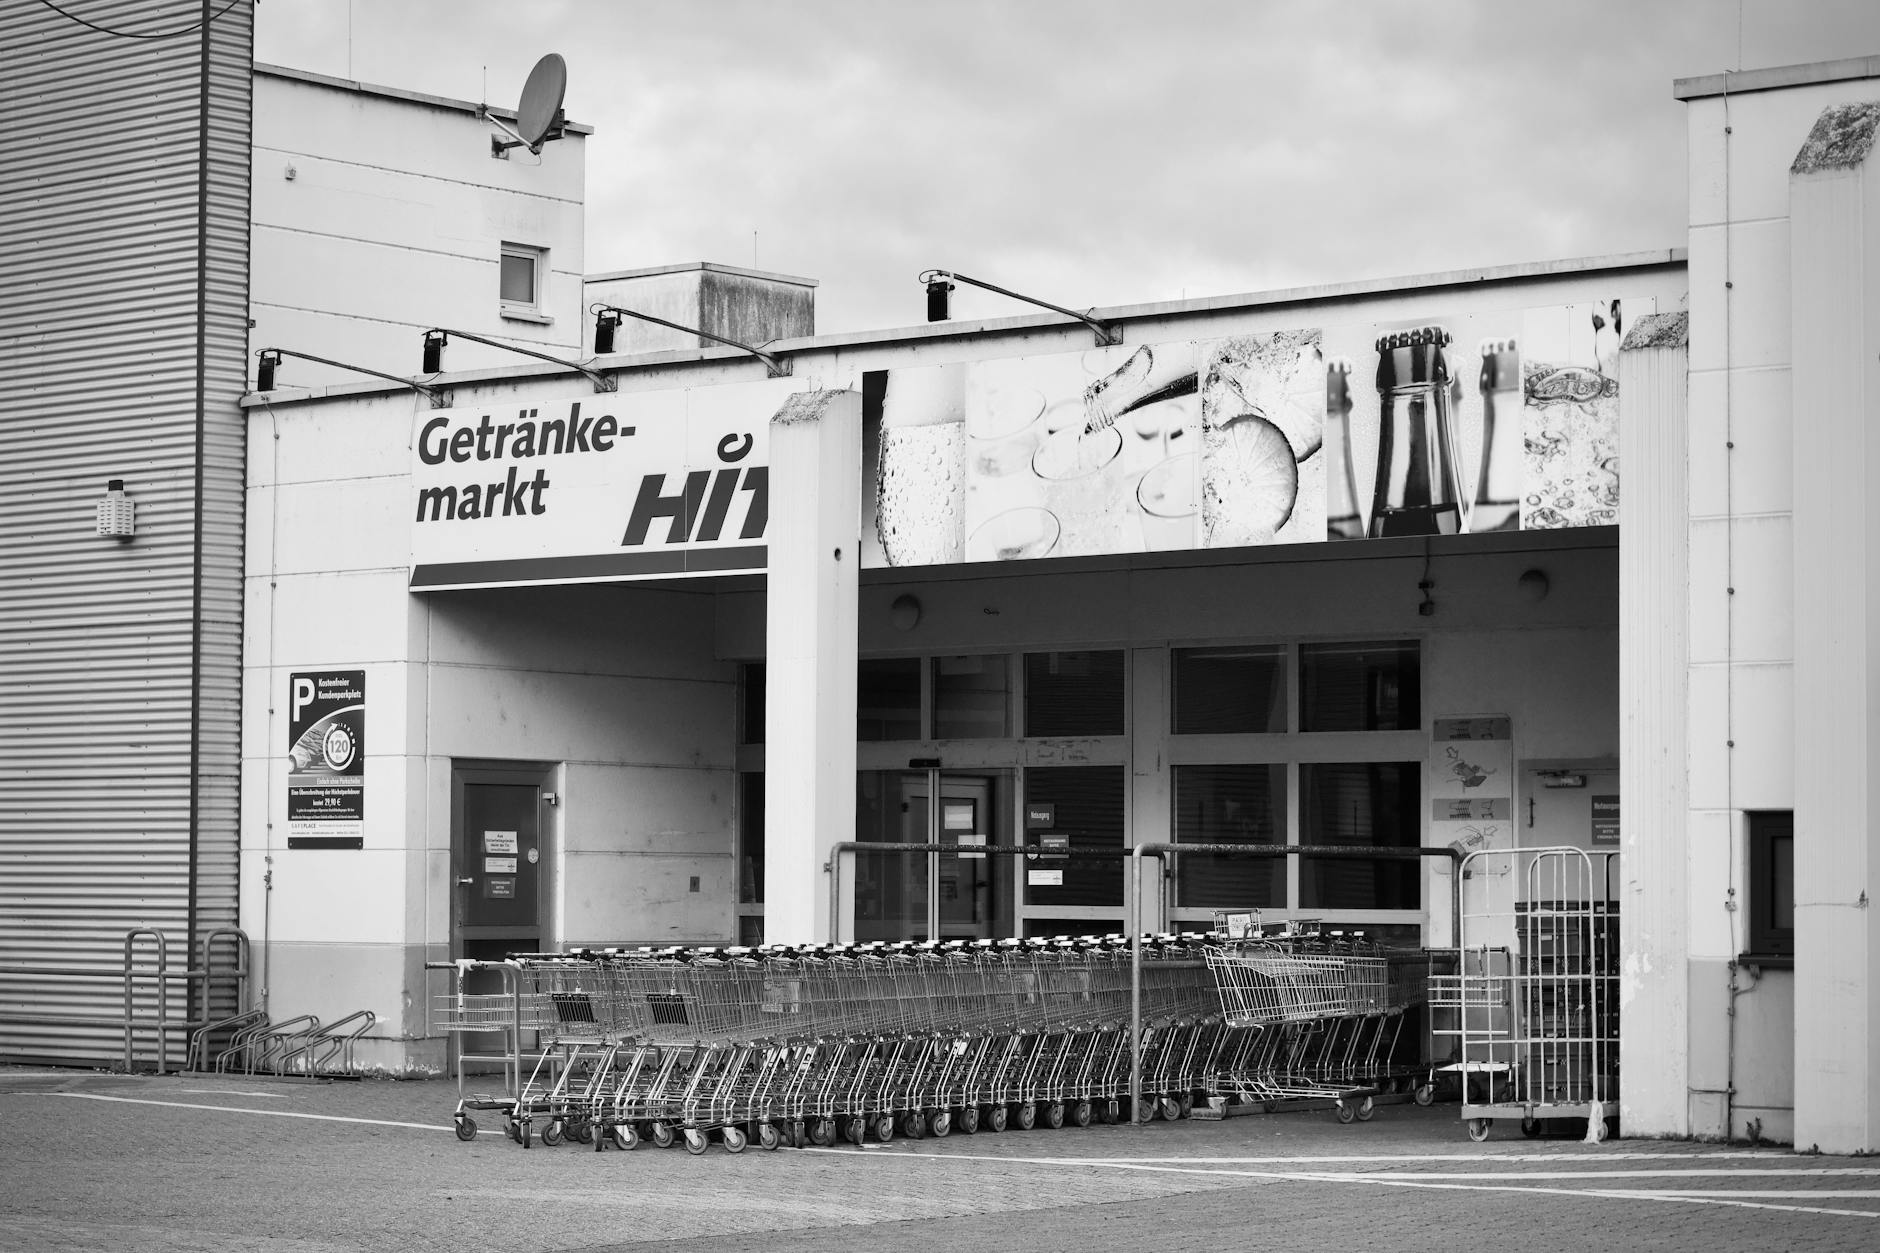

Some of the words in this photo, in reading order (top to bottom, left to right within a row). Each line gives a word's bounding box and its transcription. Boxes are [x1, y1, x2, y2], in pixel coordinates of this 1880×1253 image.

[418, 402, 636, 466] Getränke-
[416, 467, 550, 523] markt
[621, 465, 769, 546] HIT
[293, 678, 315, 722] P
[318, 688, 362, 701] Kundenparkplatz
[330, 740, 349, 753] 120
